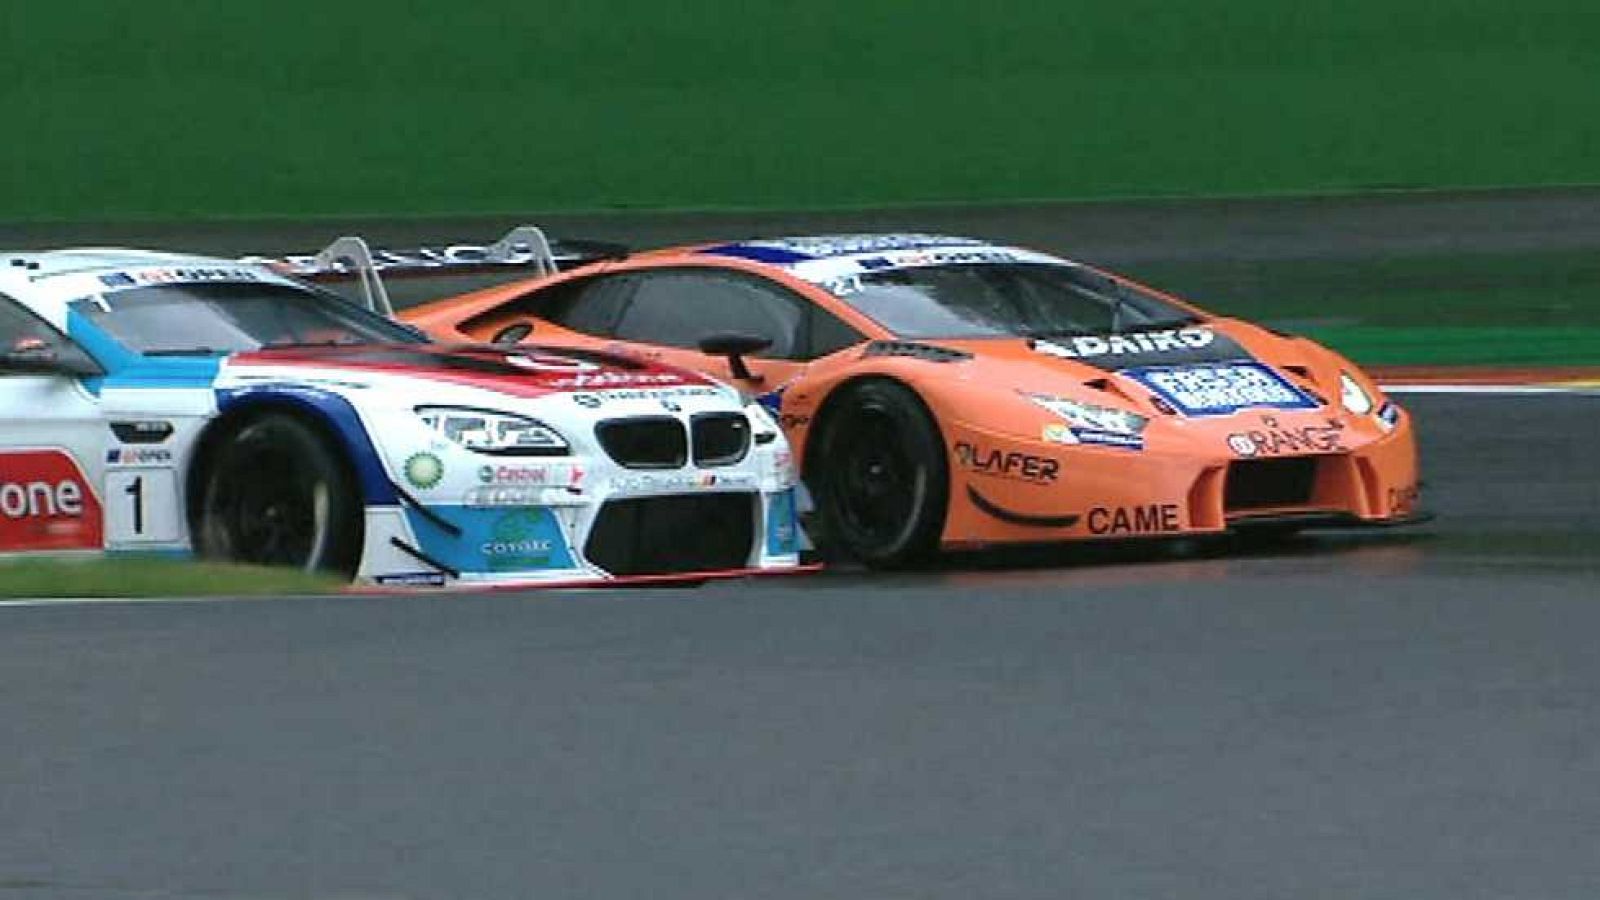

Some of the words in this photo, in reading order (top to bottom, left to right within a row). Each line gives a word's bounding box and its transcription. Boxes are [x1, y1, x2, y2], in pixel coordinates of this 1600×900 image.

[1072, 327, 1215, 356] DAIKO
[125, 475, 143, 535] 1
[1087, 503, 1180, 535] CAME
